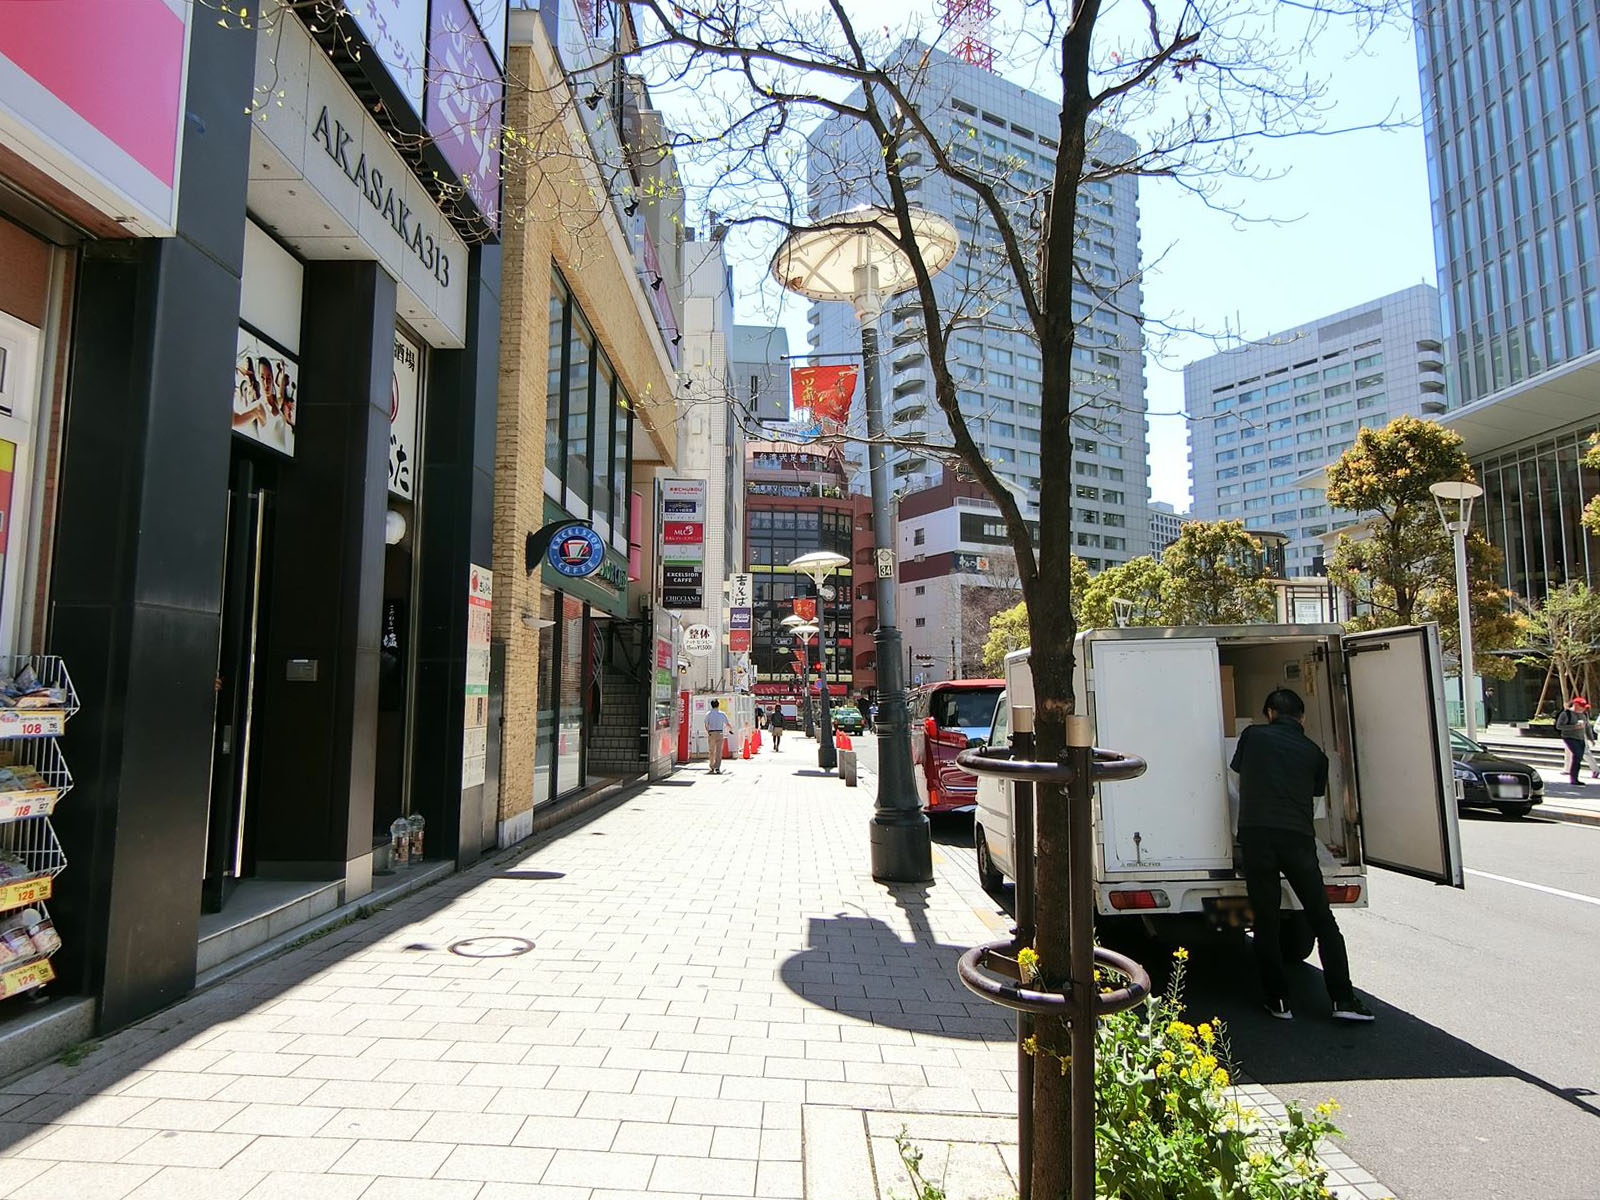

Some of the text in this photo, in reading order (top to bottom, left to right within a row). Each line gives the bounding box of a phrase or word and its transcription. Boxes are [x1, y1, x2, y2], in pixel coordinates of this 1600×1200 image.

[312, 104, 450, 289] AKASAKA313
[552, 527, 601, 550] EXCELSIOR
[880, 565, 892, 577] 34
[688, 629, 710, 639] 整体
[22, 723, 42, 734] 108
[14, 804, 31, 817] 118
[18, 889, 35, 902] 128
